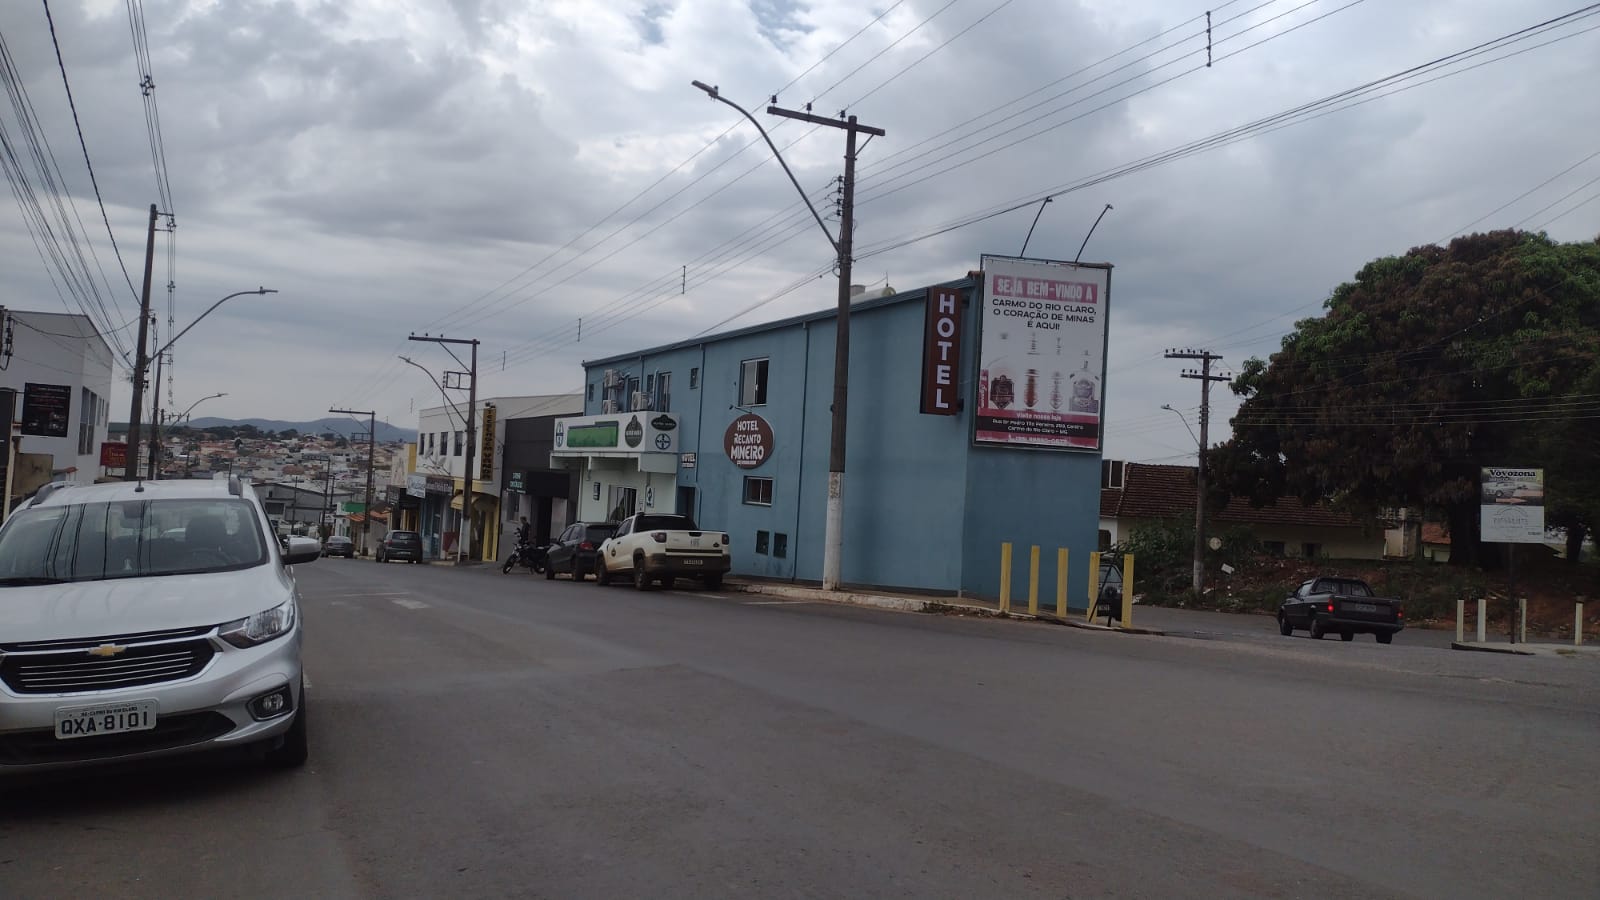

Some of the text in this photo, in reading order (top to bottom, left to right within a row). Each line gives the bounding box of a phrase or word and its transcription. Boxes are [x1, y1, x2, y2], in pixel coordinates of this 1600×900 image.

[997, 278, 1092, 301] SEJA BEM-VINDO A
[992, 299, 1097, 315] CARMO DO RIO CLARO,
[1003, 309, 1049, 319] CORAÇÃO
[1065, 314, 1095, 323] MINAS
[1027, 318, 1060, 331] É AQUI!
[936, 294, 955, 408] HOTEL
[737, 420, 759, 431] HOTEL
[734, 433, 762, 444] RECANTO
[731, 445, 764, 460] MINEIRO
[1489, 469, 1536, 477] Vovozona
